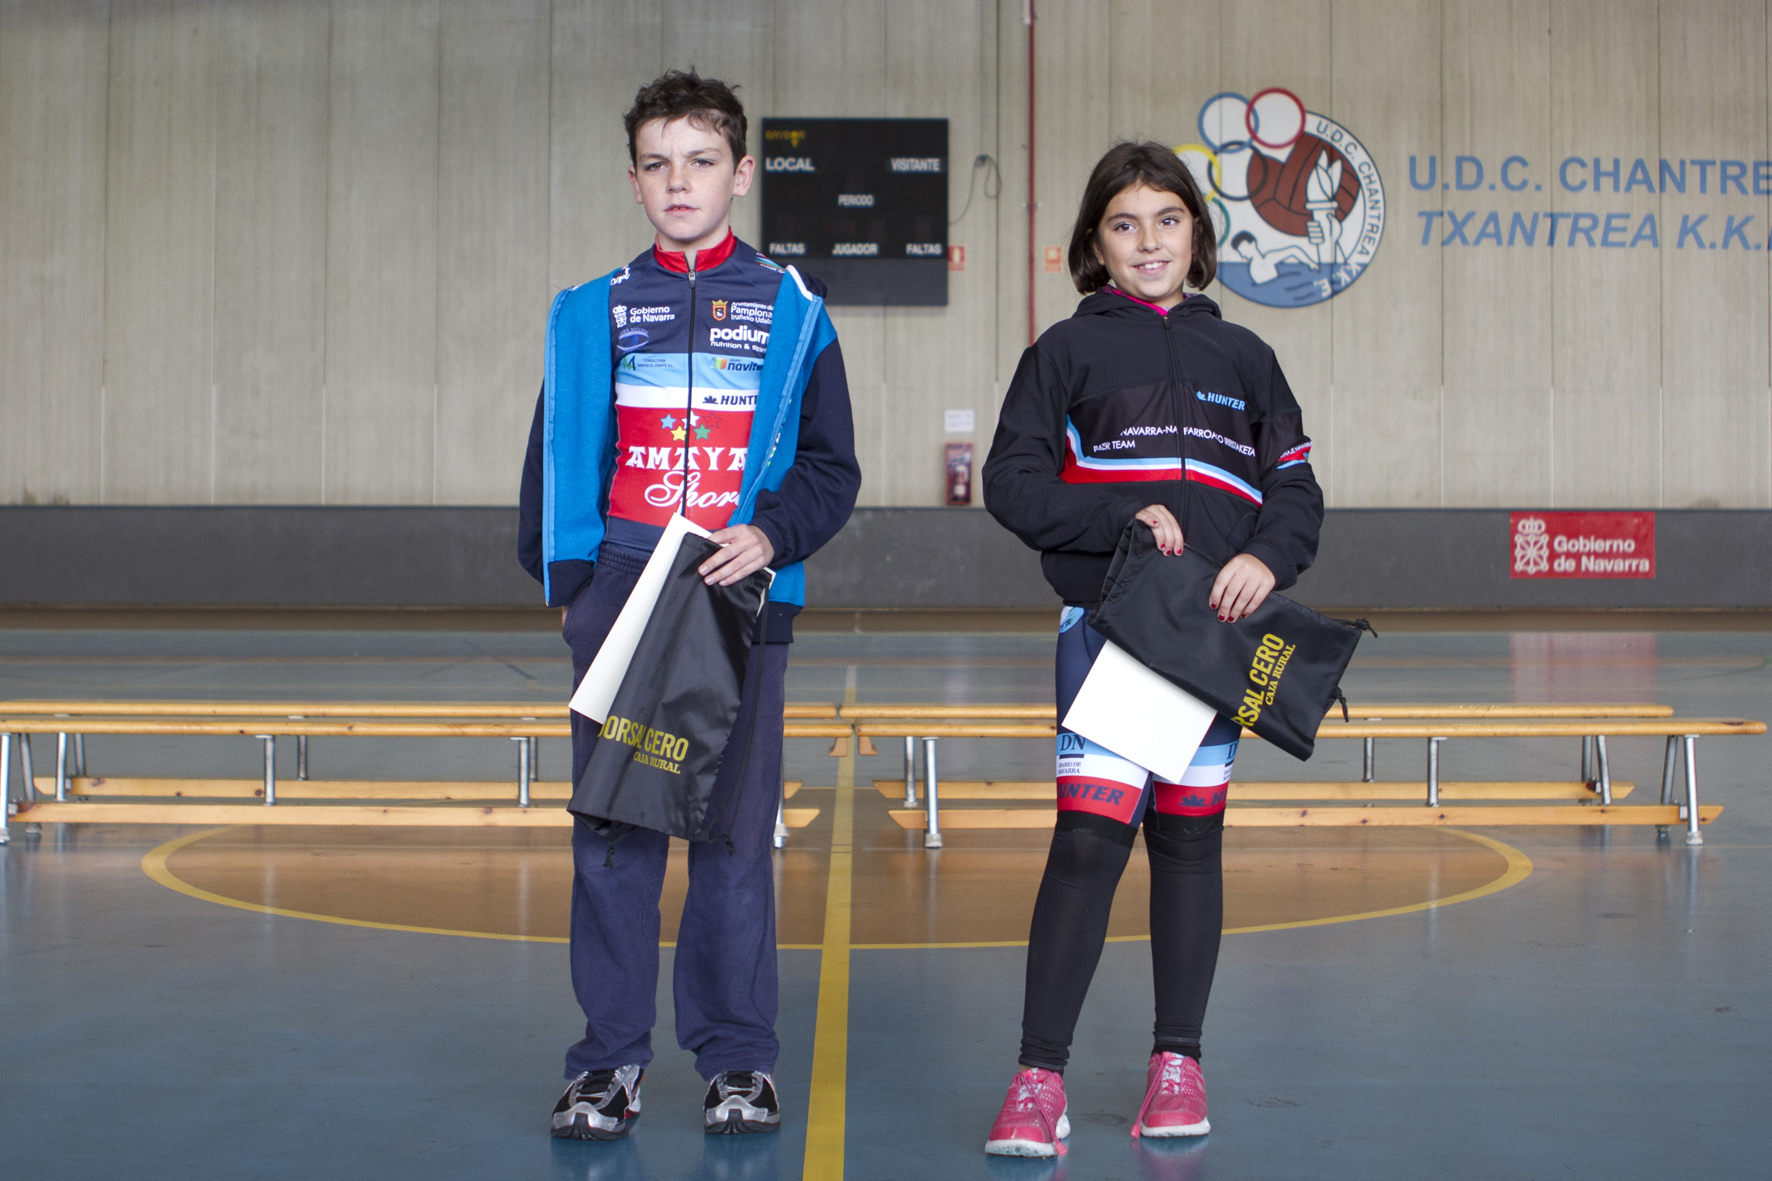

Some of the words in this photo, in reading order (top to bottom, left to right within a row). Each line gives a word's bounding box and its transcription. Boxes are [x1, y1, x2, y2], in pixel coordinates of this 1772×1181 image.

[766, 157, 815, 171] LOCAL
[891, 157, 940, 172] VISITANTE
[1408, 155, 1542, 192] U.D.C.
[838, 194, 874, 206] PERIODO
[1357, 160, 1382, 257] CHANTREA
[1417, 210, 1660, 249] TXANTREA
[769, 243, 805, 255] FALTAS
[832, 243, 878, 256] JUGADOR
[906, 243, 942, 255] FALTAS
[629, 306, 671, 316] Gobierno
[730, 305, 773, 319] Pamplona
[731, 301, 767, 310] Ayuntamiento
[629, 314, 642, 324] de
[642, 312, 676, 323] Navarra
[709, 325, 770, 345] podium
[710, 341, 743, 350] nutrition
[743, 343, 751, 351] &
[1207, 391, 1246, 411] HUNTER
[1111, 439, 1136, 450] TEAM
[625, 446, 748, 471] AMAYA
[1553, 535, 1636, 553] Gobierno
[1553, 555, 1576, 573] de
[1581, 555, 1650, 573] Navarra
[1249, 633, 1285, 687] CERO
[1265, 680, 1278, 706] CAJA
[1272, 644, 1297, 680] RURAL
[644, 728, 689, 762] CERO
[1060, 734, 1086, 751] DN
[633, 751, 649, 765] CAJA
[649, 756, 681, 774] RURAL
